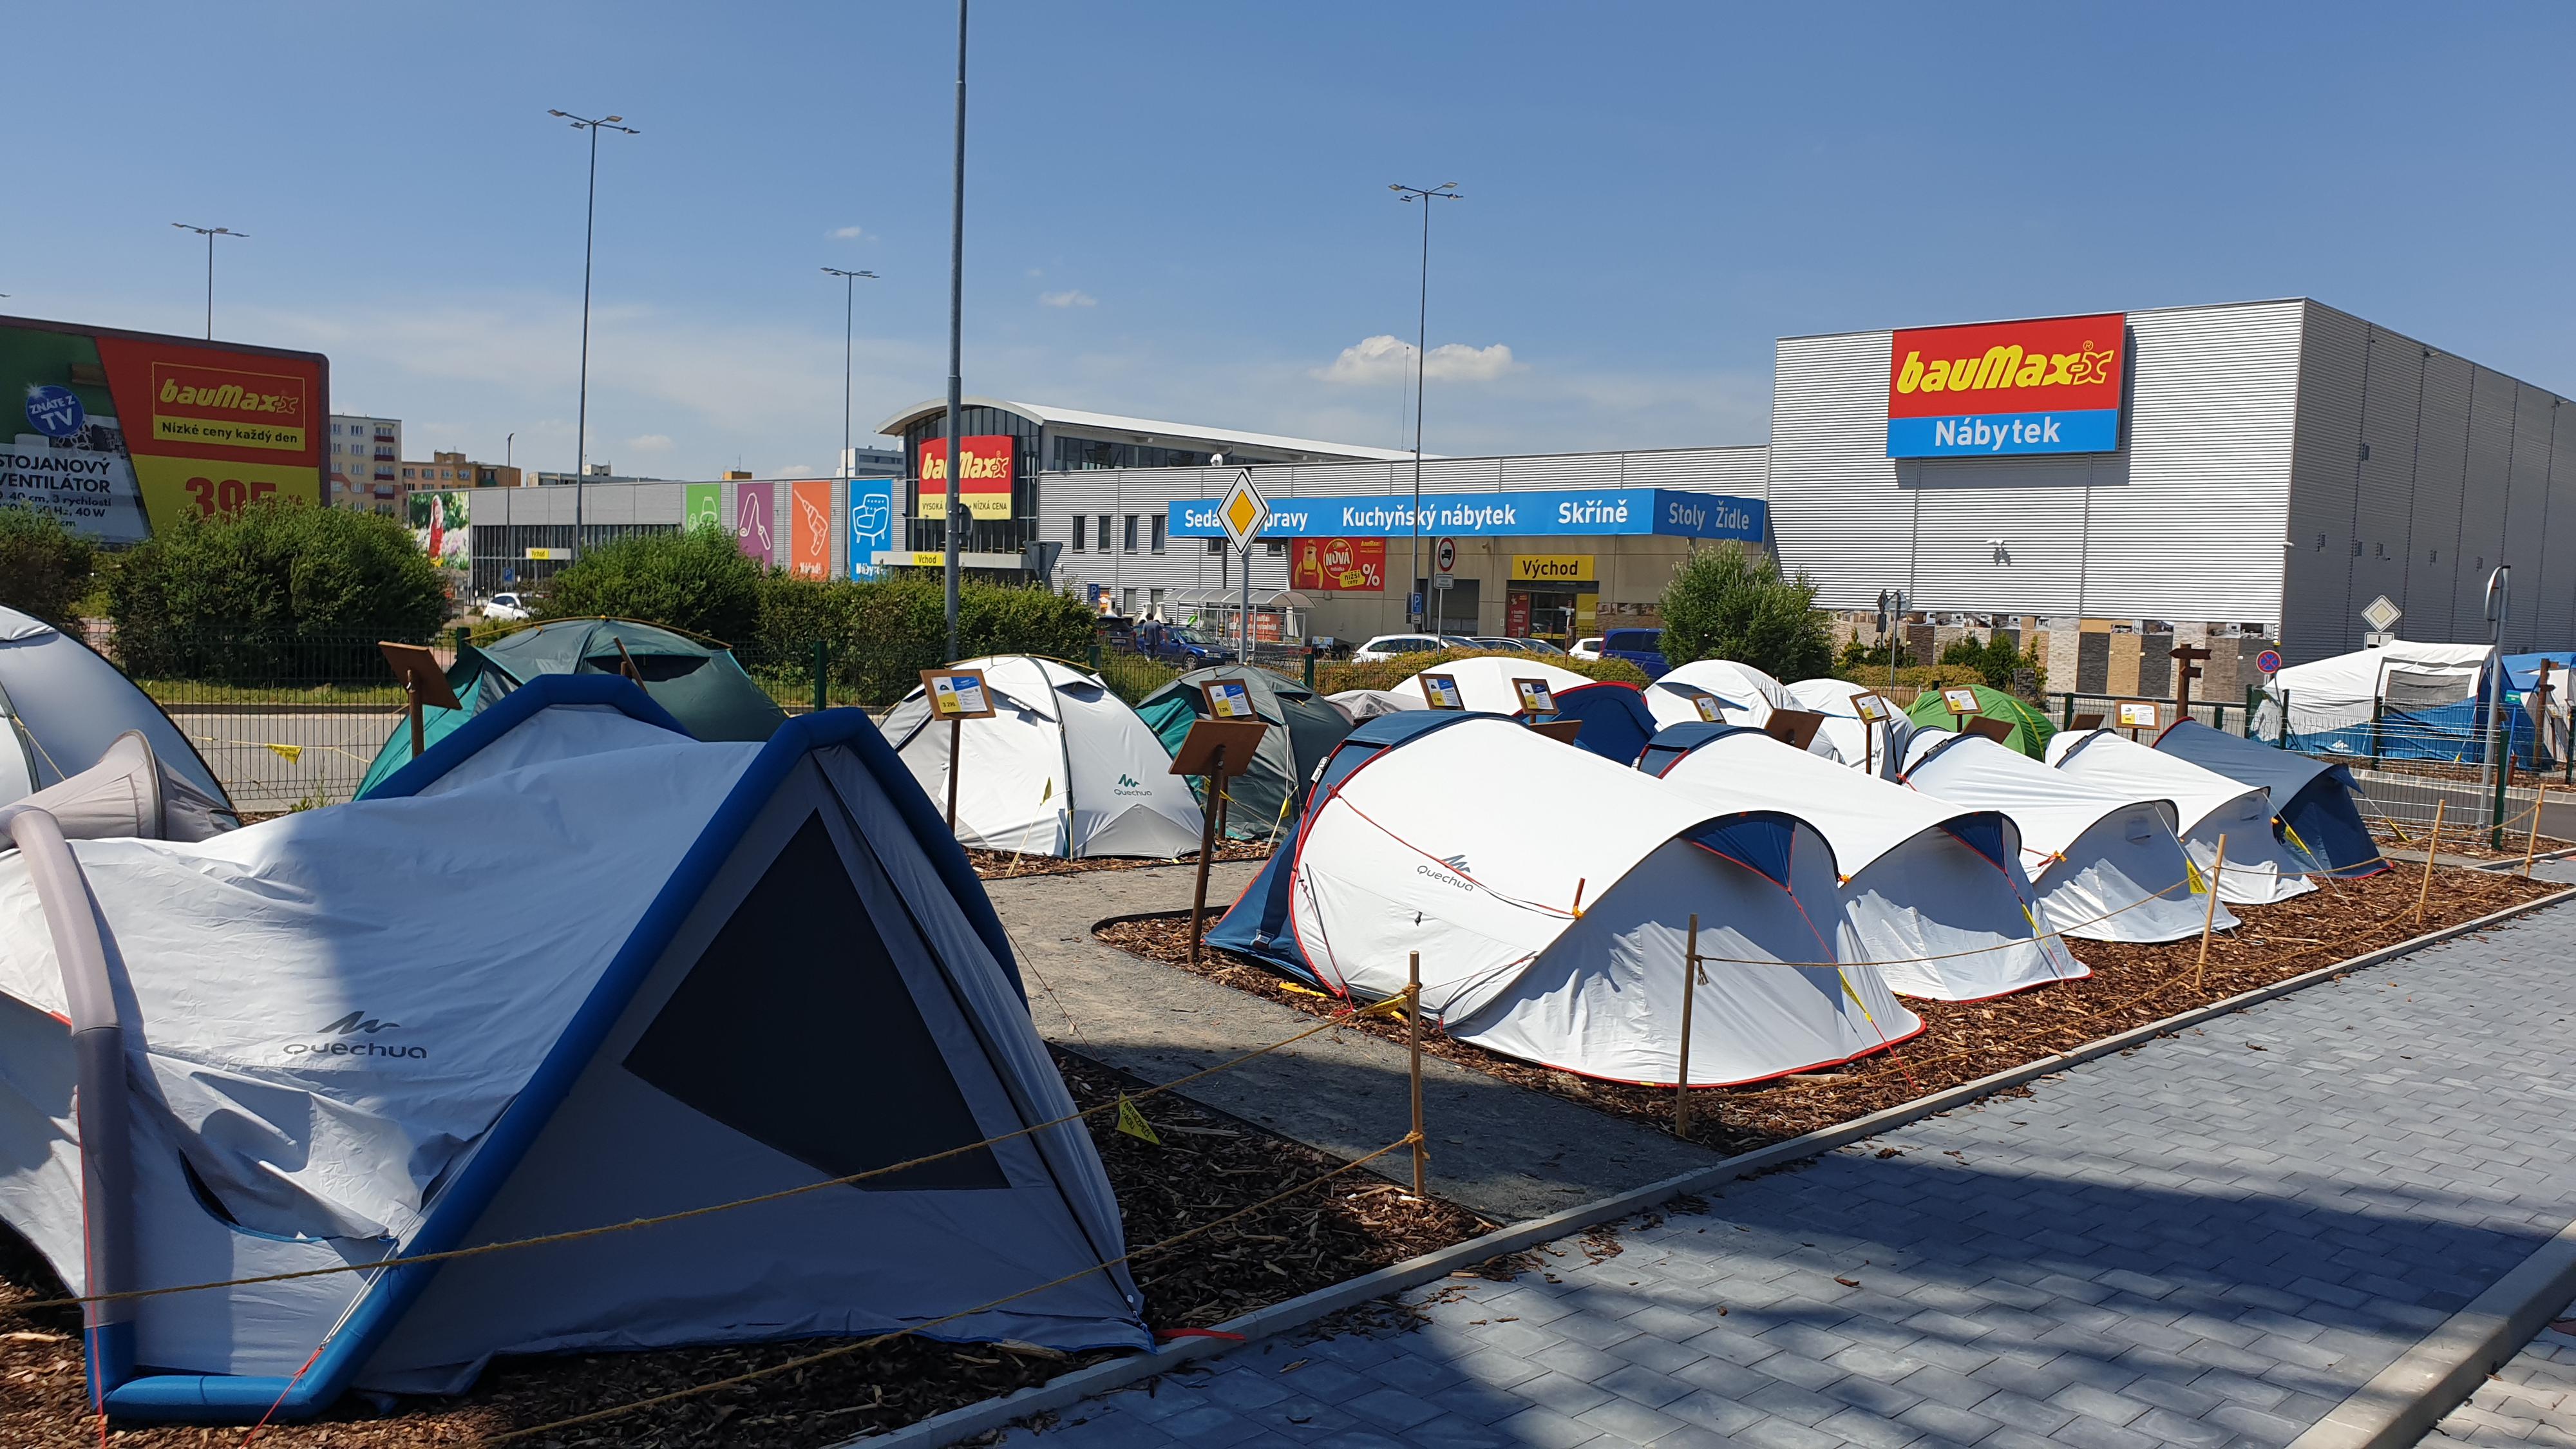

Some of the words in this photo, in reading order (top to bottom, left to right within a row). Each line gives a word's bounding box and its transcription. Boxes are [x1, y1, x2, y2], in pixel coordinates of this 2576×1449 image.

[29, 397, 65, 414] ZNÁTE
[66, 395, 75, 405] Z
[41, 408, 72, 430] TV
[203, 428, 232, 440] ceny
[236, 429, 272, 443] každý
[275, 433, 298, 443] den
[1935, 417, 2061, 450] Nábytek
[53, 494, 60, 502] 3
[63, 496, 111, 507] rychlosti
[922, 500, 943, 510] VYSOKÁ
[973, 500, 990, 510] NÍZKÁ
[76, 507, 91, 517] 40
[93, 509, 106, 518] W
[1185, 509, 1221, 527] Seda
[1343, 504, 1437, 531] Kuchyňský
[1441, 504, 1517, 530] nábytek
[1558, 498, 1629, 524] Skříně
[1669, 502, 1706, 531] Stoly
[1715, 500, 1750, 530] Židle
[918, 554, 937, 564] Vchod
[1325, 547, 1350, 566] NOVÁ
[1522, 559, 1578, 579] Východ
[1417, 865, 1474, 892] Quechua
[283, 1043, 428, 1059] Quechua
